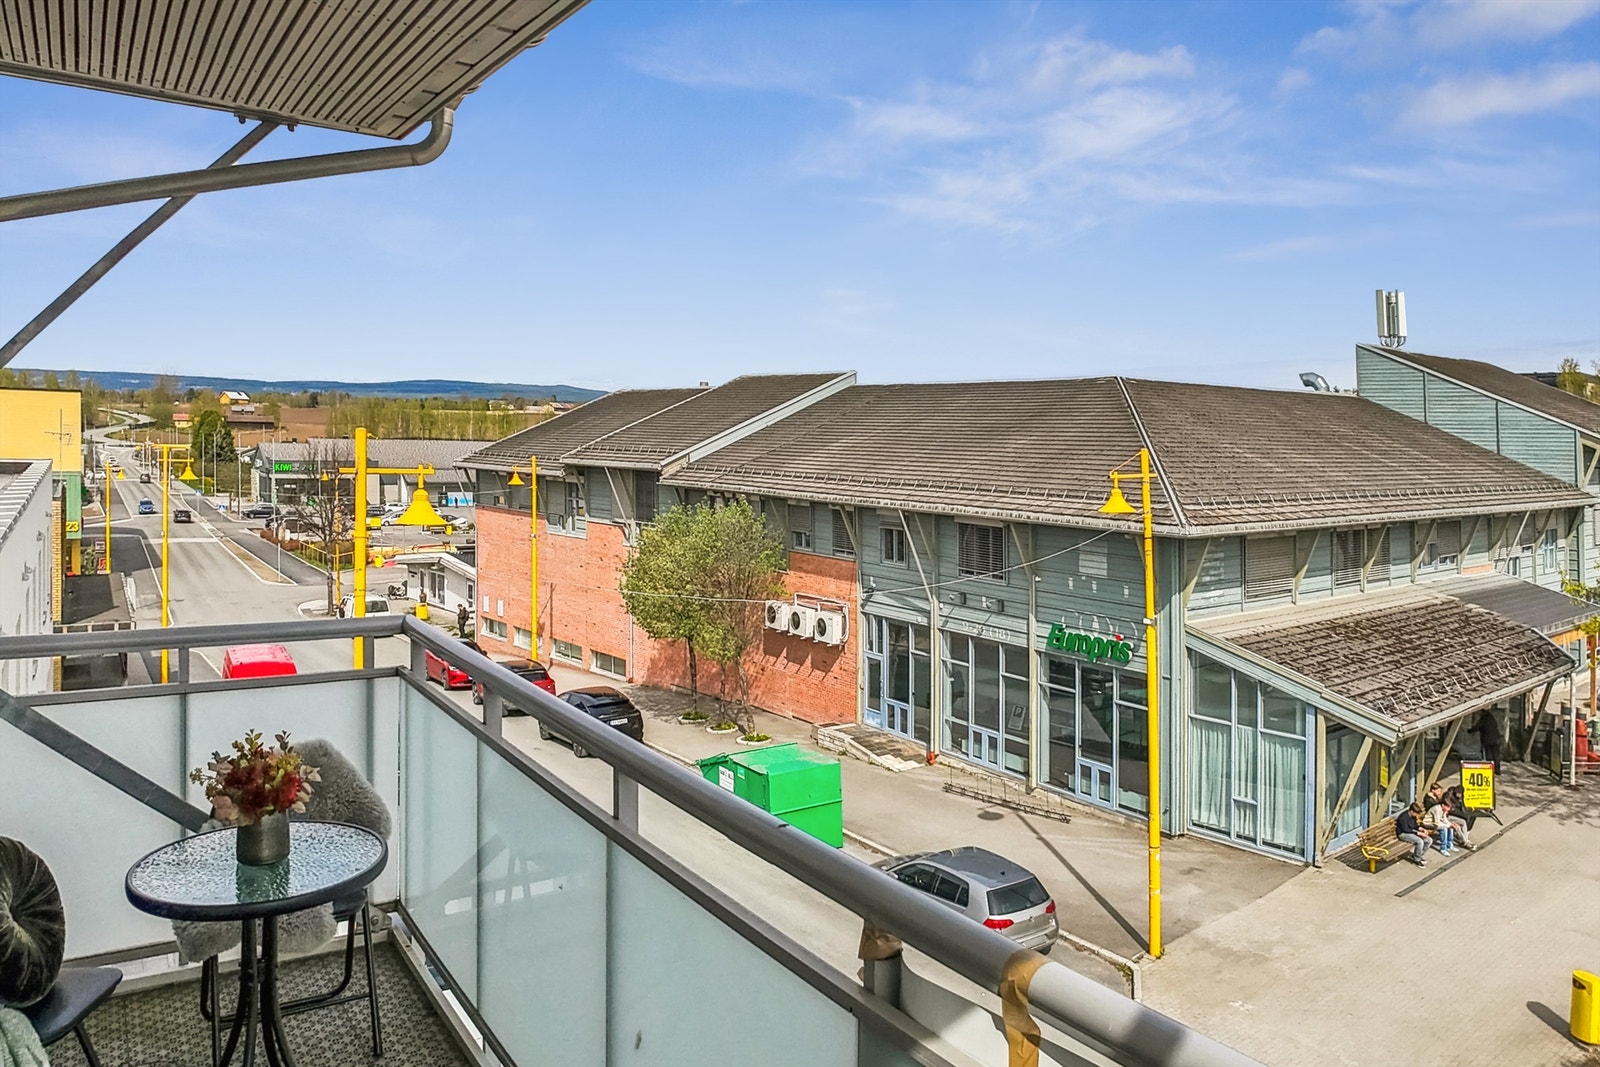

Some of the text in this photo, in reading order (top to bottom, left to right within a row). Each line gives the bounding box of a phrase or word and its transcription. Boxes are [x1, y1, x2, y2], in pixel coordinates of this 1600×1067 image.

[274, 463, 292, 472] KIWI
[1047, 623, 1134, 663] Europris
[1465, 773, 1491, 787] -40%
